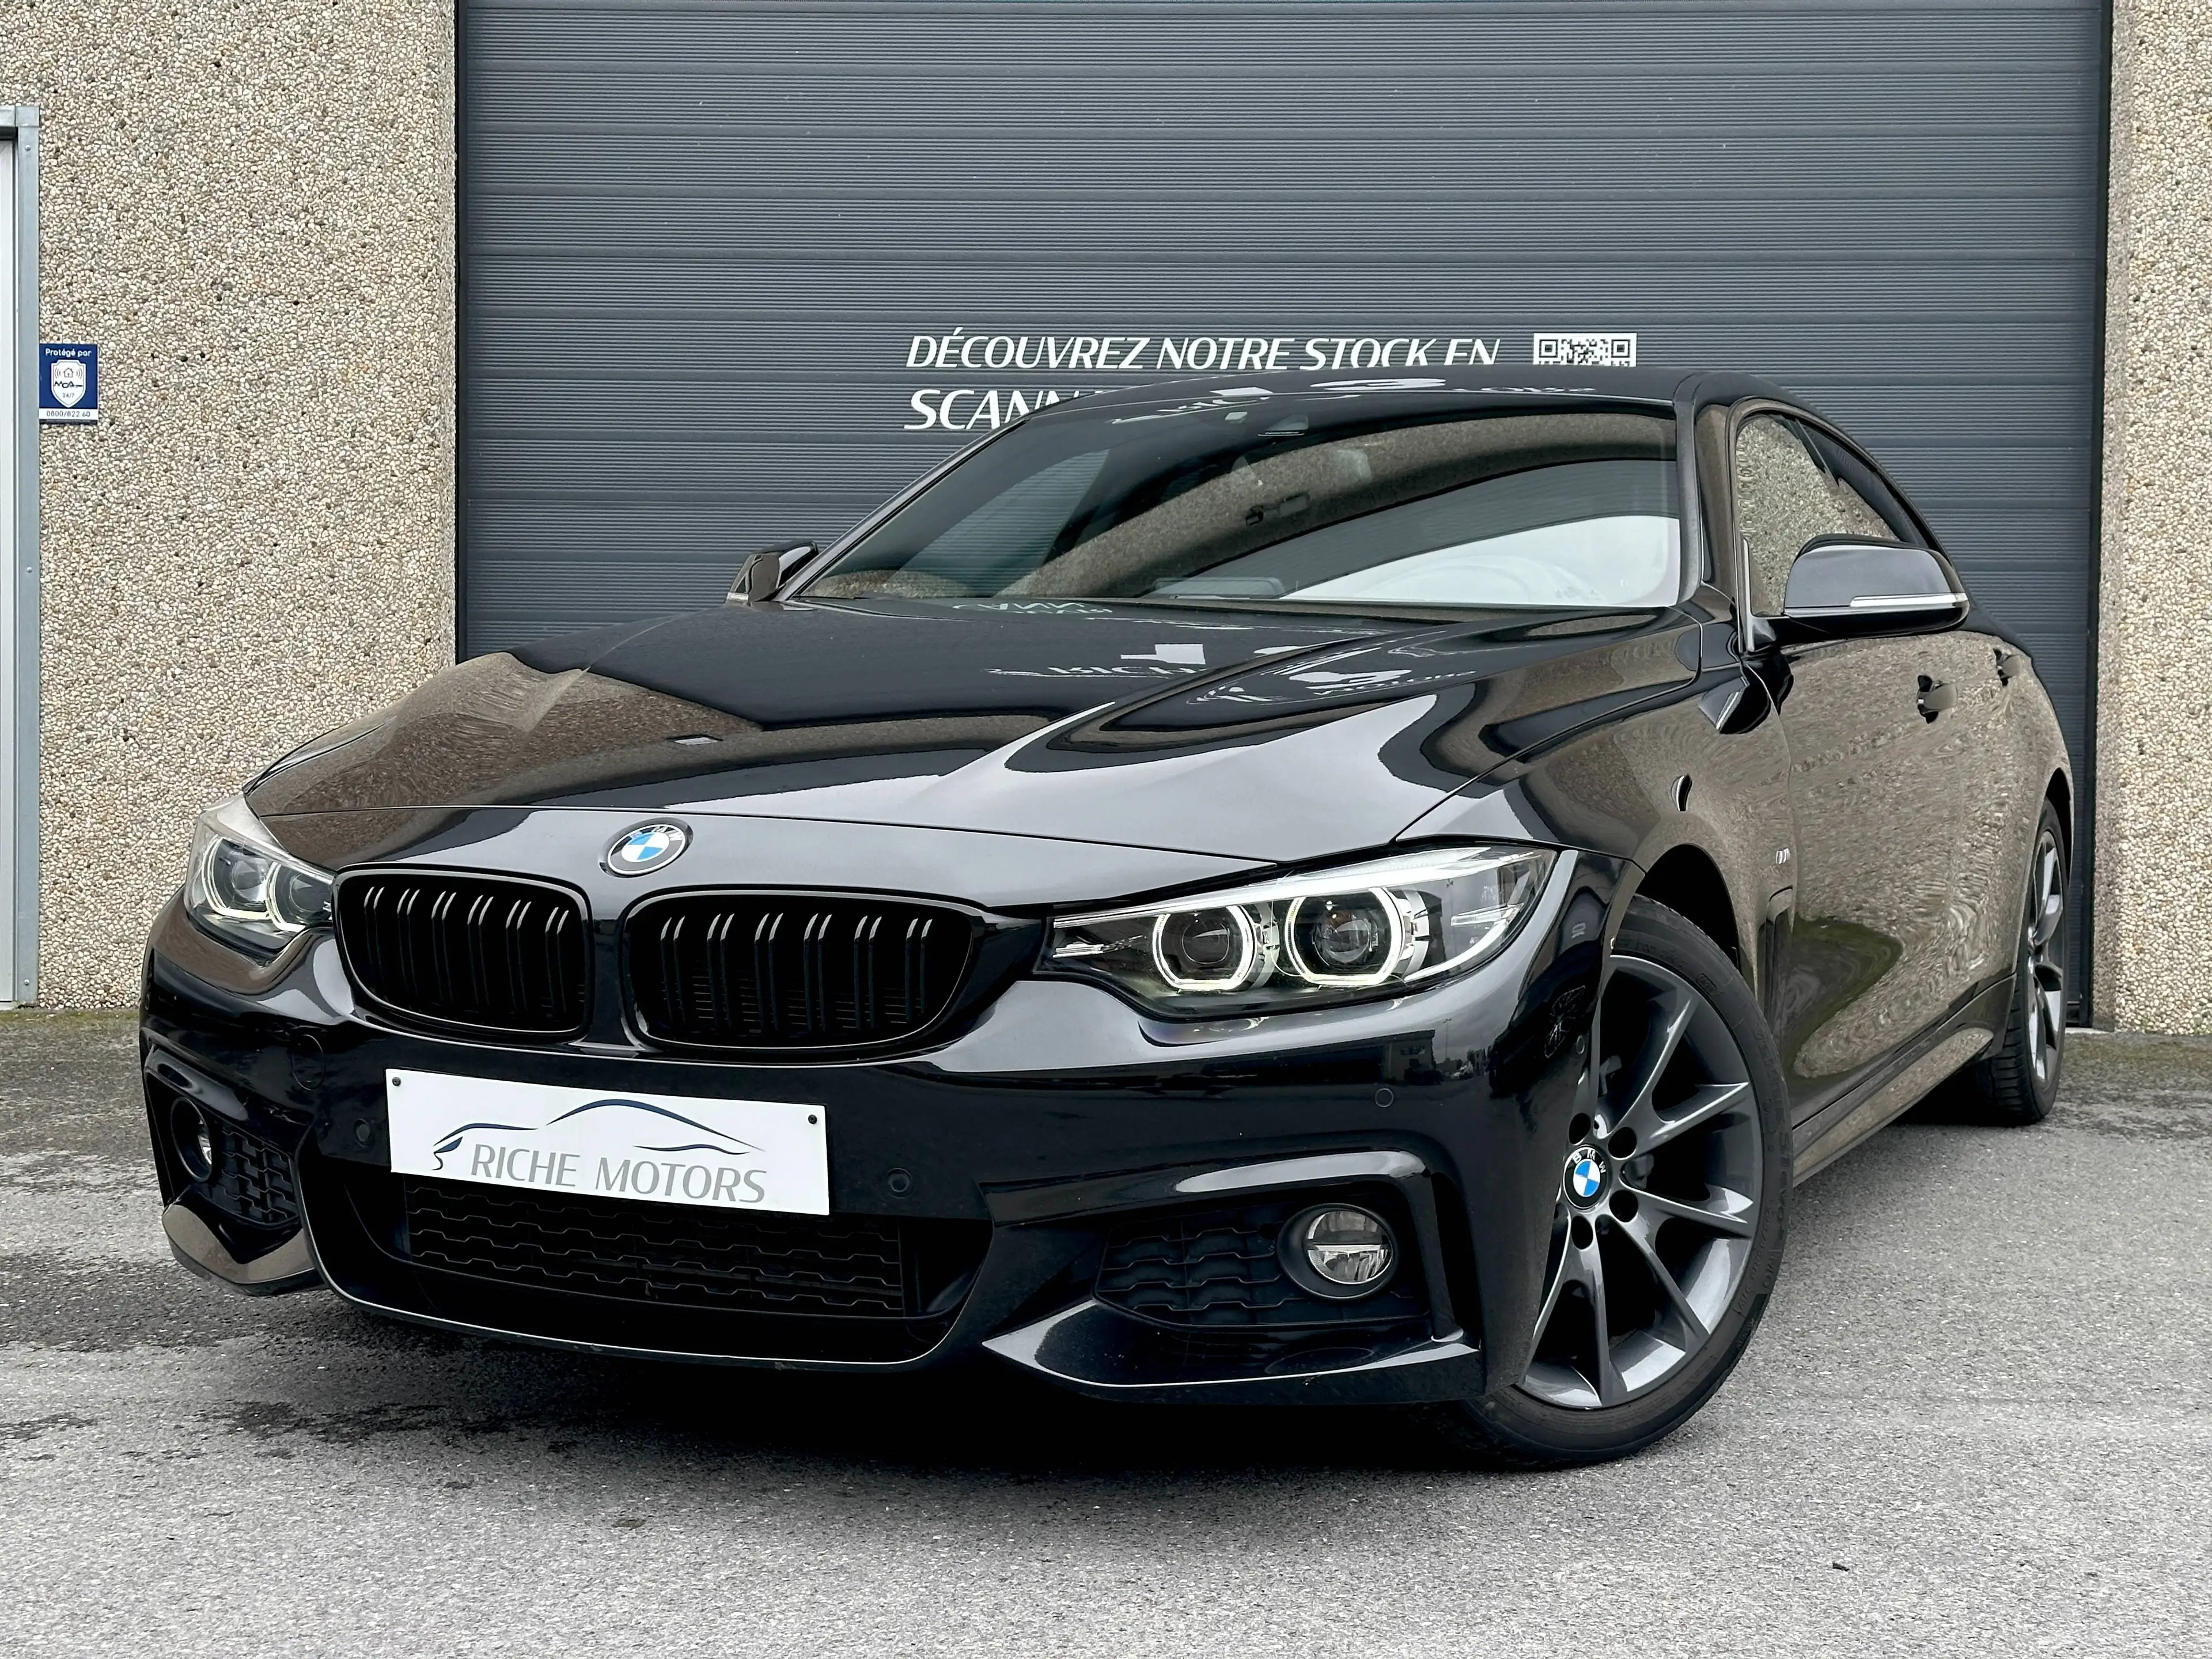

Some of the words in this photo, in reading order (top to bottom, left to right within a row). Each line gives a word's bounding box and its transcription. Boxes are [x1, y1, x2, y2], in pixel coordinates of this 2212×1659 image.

[45, 348, 76, 357] Protégé
[906, 327, 1151, 369] DÉCOUVREZ
[1156, 337, 1296, 370] NOTRE
[1300, 338, 1437, 370] STOCK
[1444, 338, 1501, 366] EN
[471, 1143, 581, 1187] RICHE
[595, 1157, 768, 1203] MOTORS
[1572, 1149, 1607, 1174] BMW
